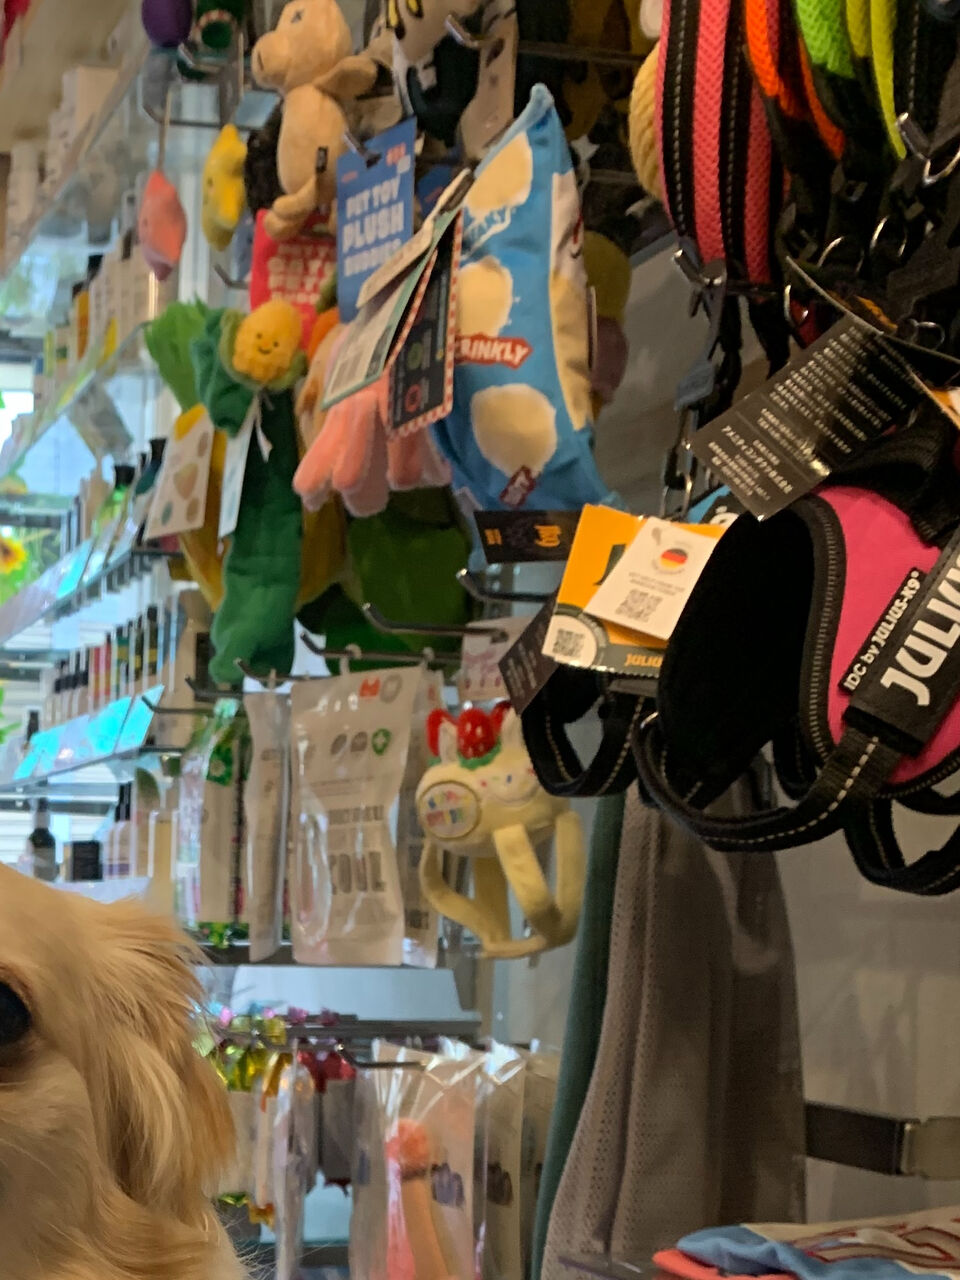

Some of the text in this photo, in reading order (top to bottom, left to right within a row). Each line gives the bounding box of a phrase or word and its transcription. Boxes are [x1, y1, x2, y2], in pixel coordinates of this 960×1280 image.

[342, 201, 404, 253] PLUSH
[456, 338, 530, 365] RINKLY
[843, 663, 867, 690] IDC
[860, 644, 880, 664] by
